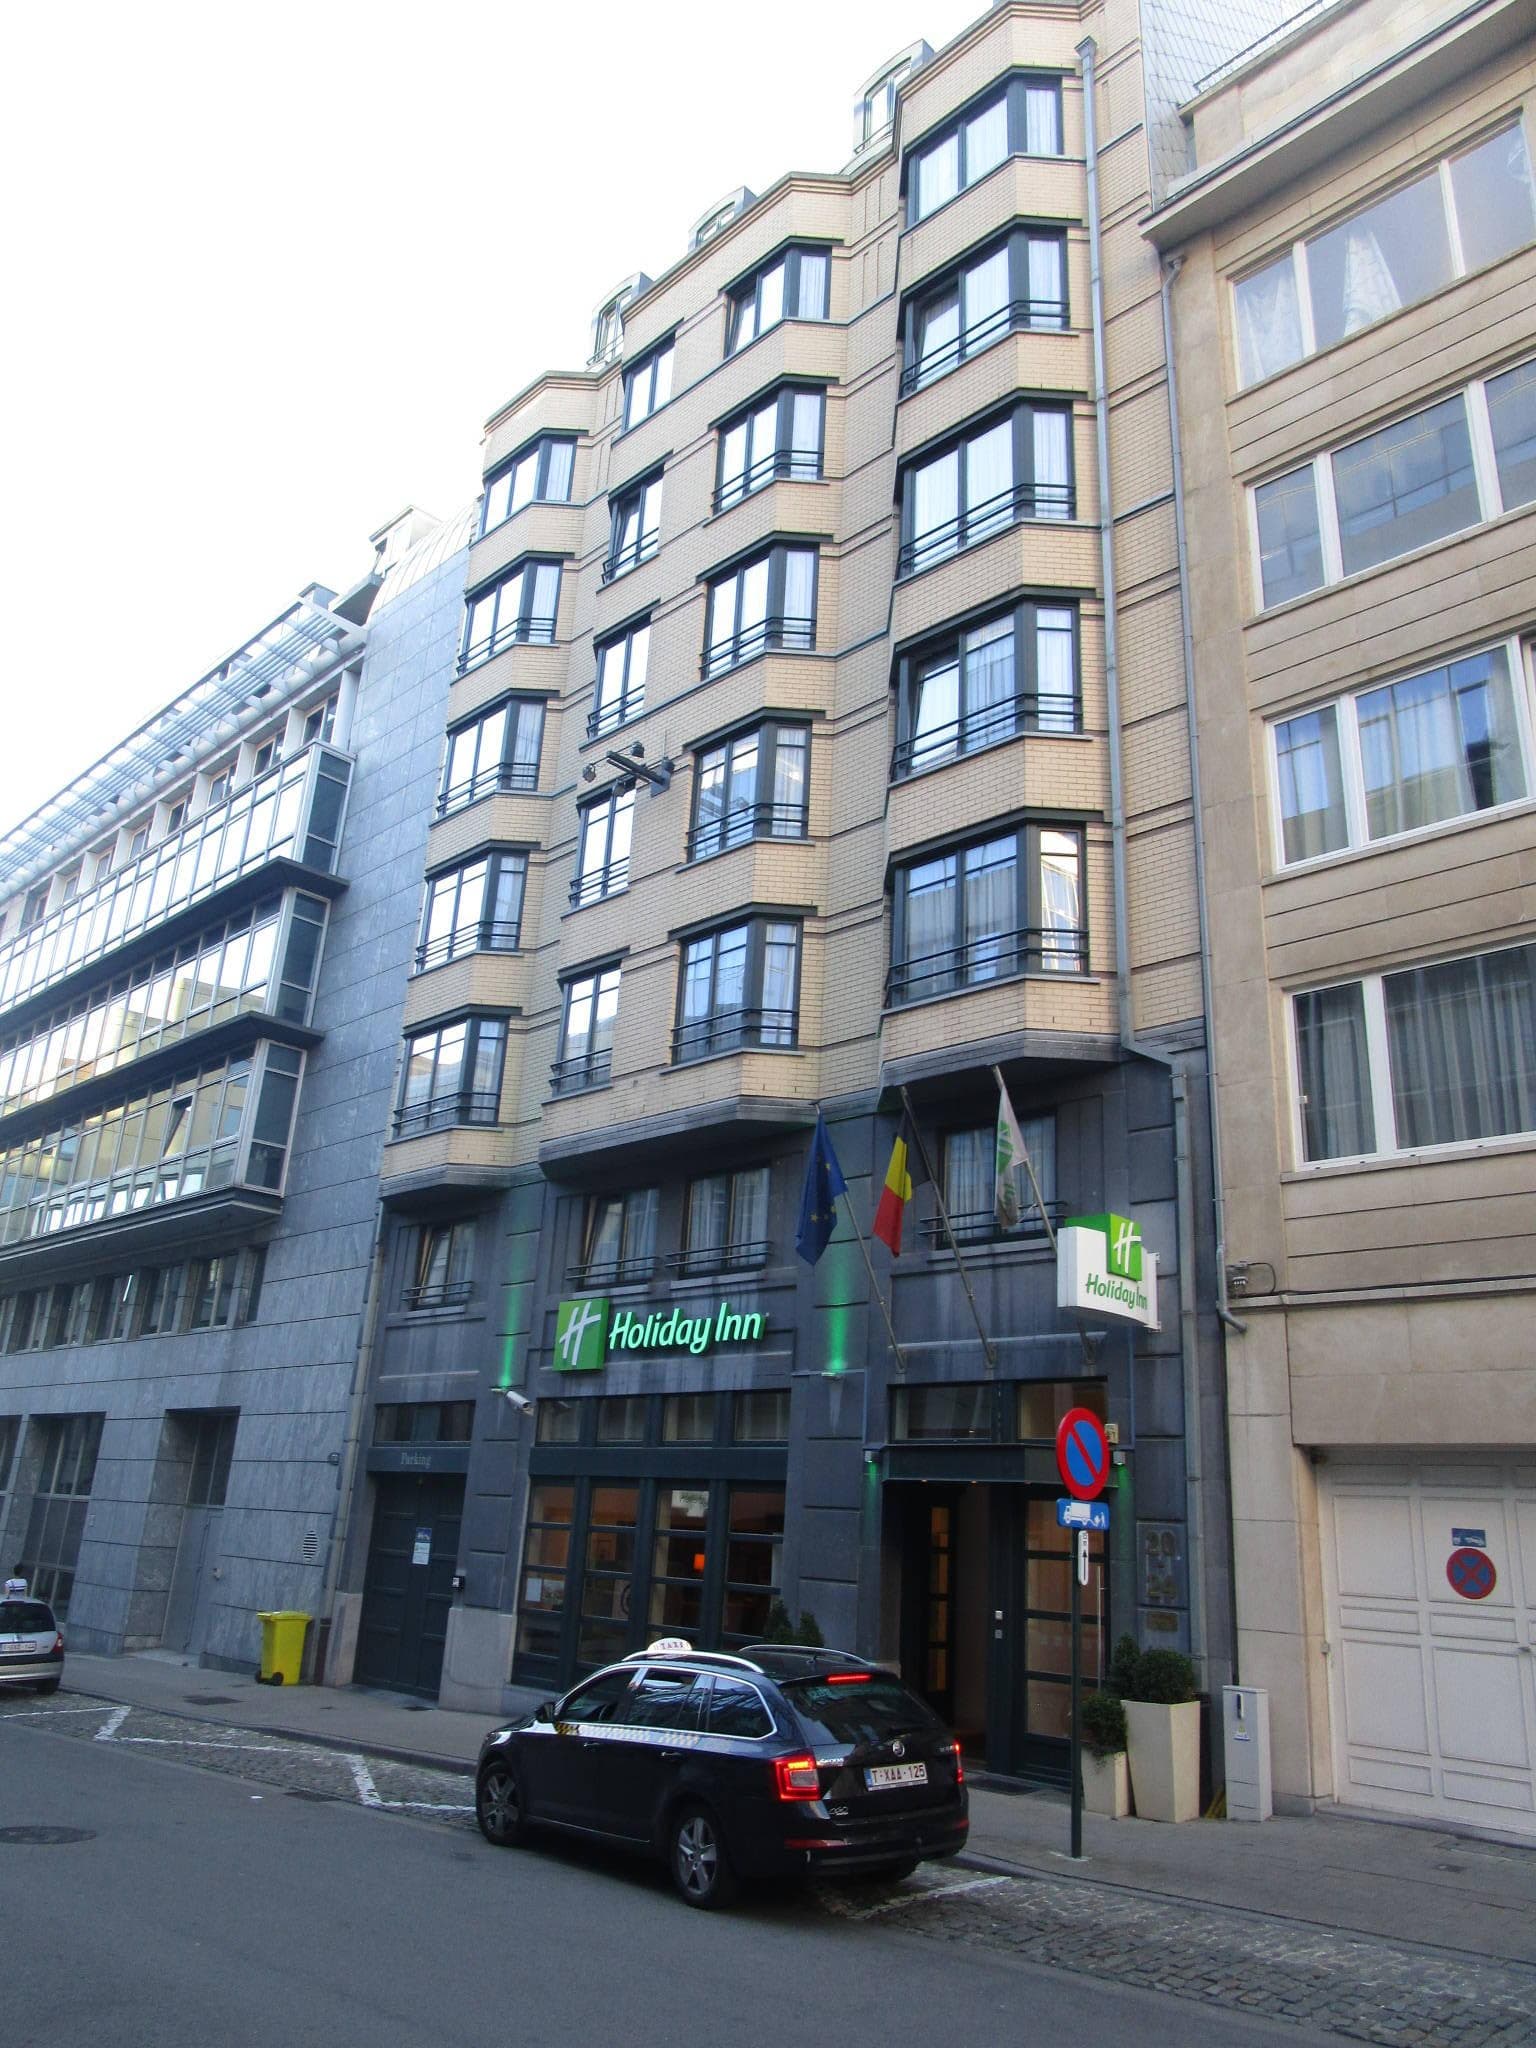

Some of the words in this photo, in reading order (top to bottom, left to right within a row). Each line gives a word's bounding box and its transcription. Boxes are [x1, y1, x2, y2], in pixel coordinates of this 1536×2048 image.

[1085, 1272, 1136, 1310] Holiday
[1135, 1285, 1148, 1310] Inn
[608, 1307, 712, 1354] Holiday
[714, 1301, 763, 1342] Inn
[400, 1451, 433, 1470] Parking
